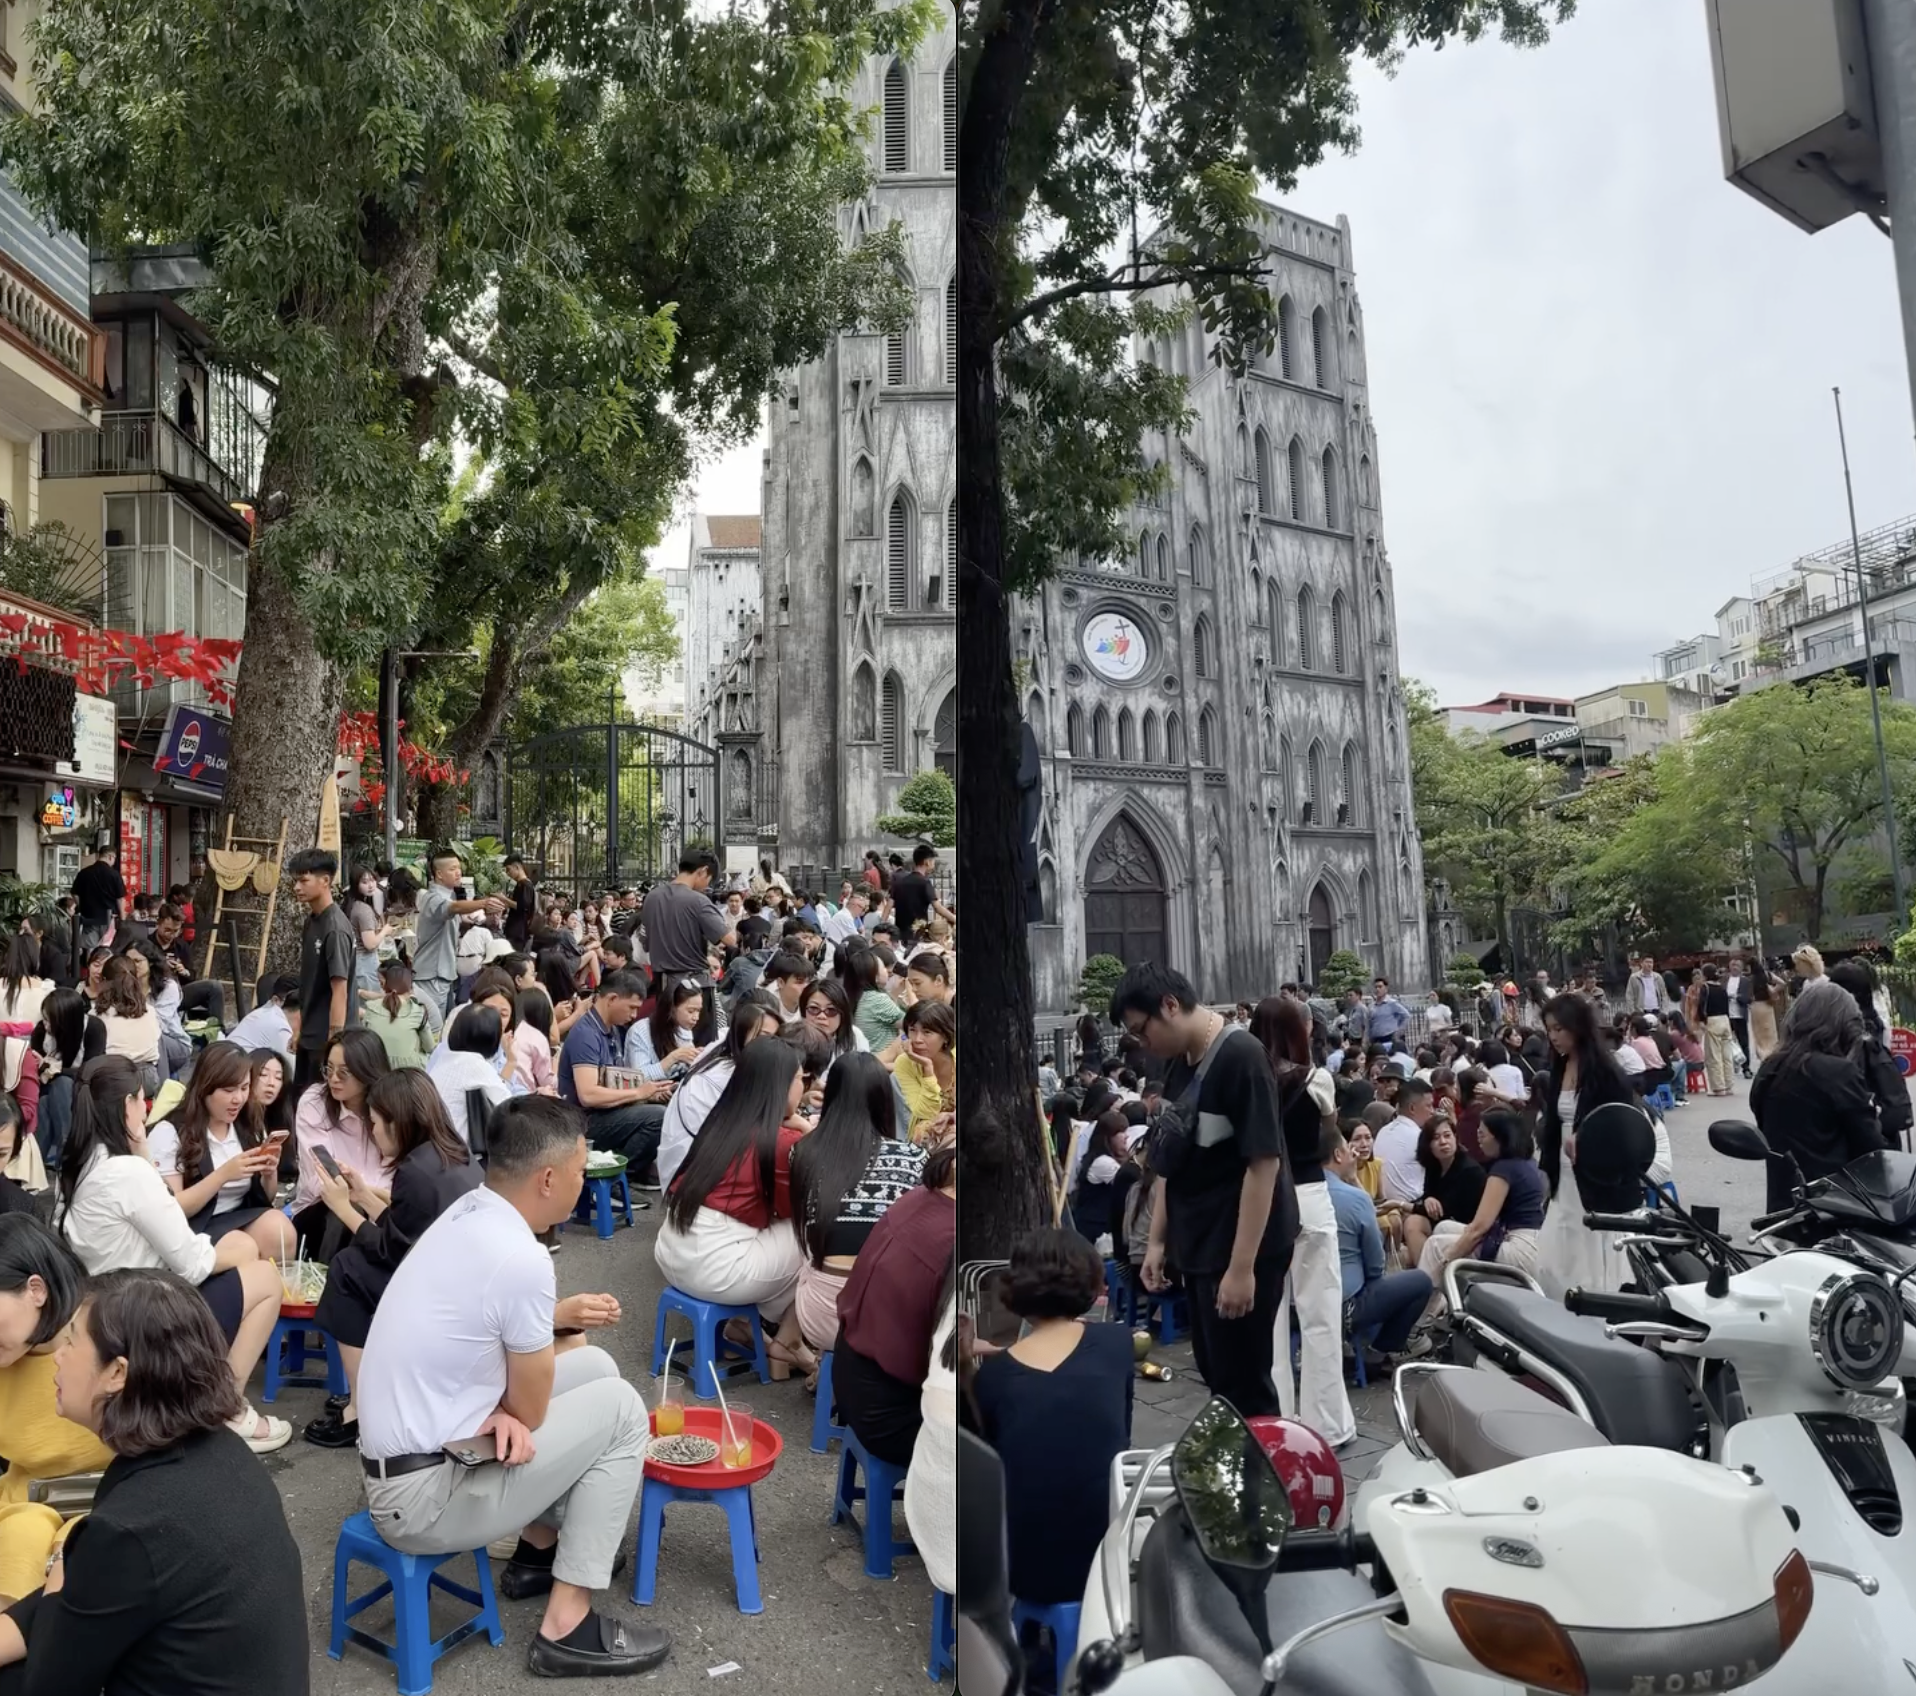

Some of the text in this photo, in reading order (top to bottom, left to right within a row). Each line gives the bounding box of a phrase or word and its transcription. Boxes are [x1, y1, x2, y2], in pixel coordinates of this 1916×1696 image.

[180, 737, 197, 750] PEPSI
[1825, 1433, 1878, 1446] VINFAST
[1630, 1658, 1760, 1696] HONDA
